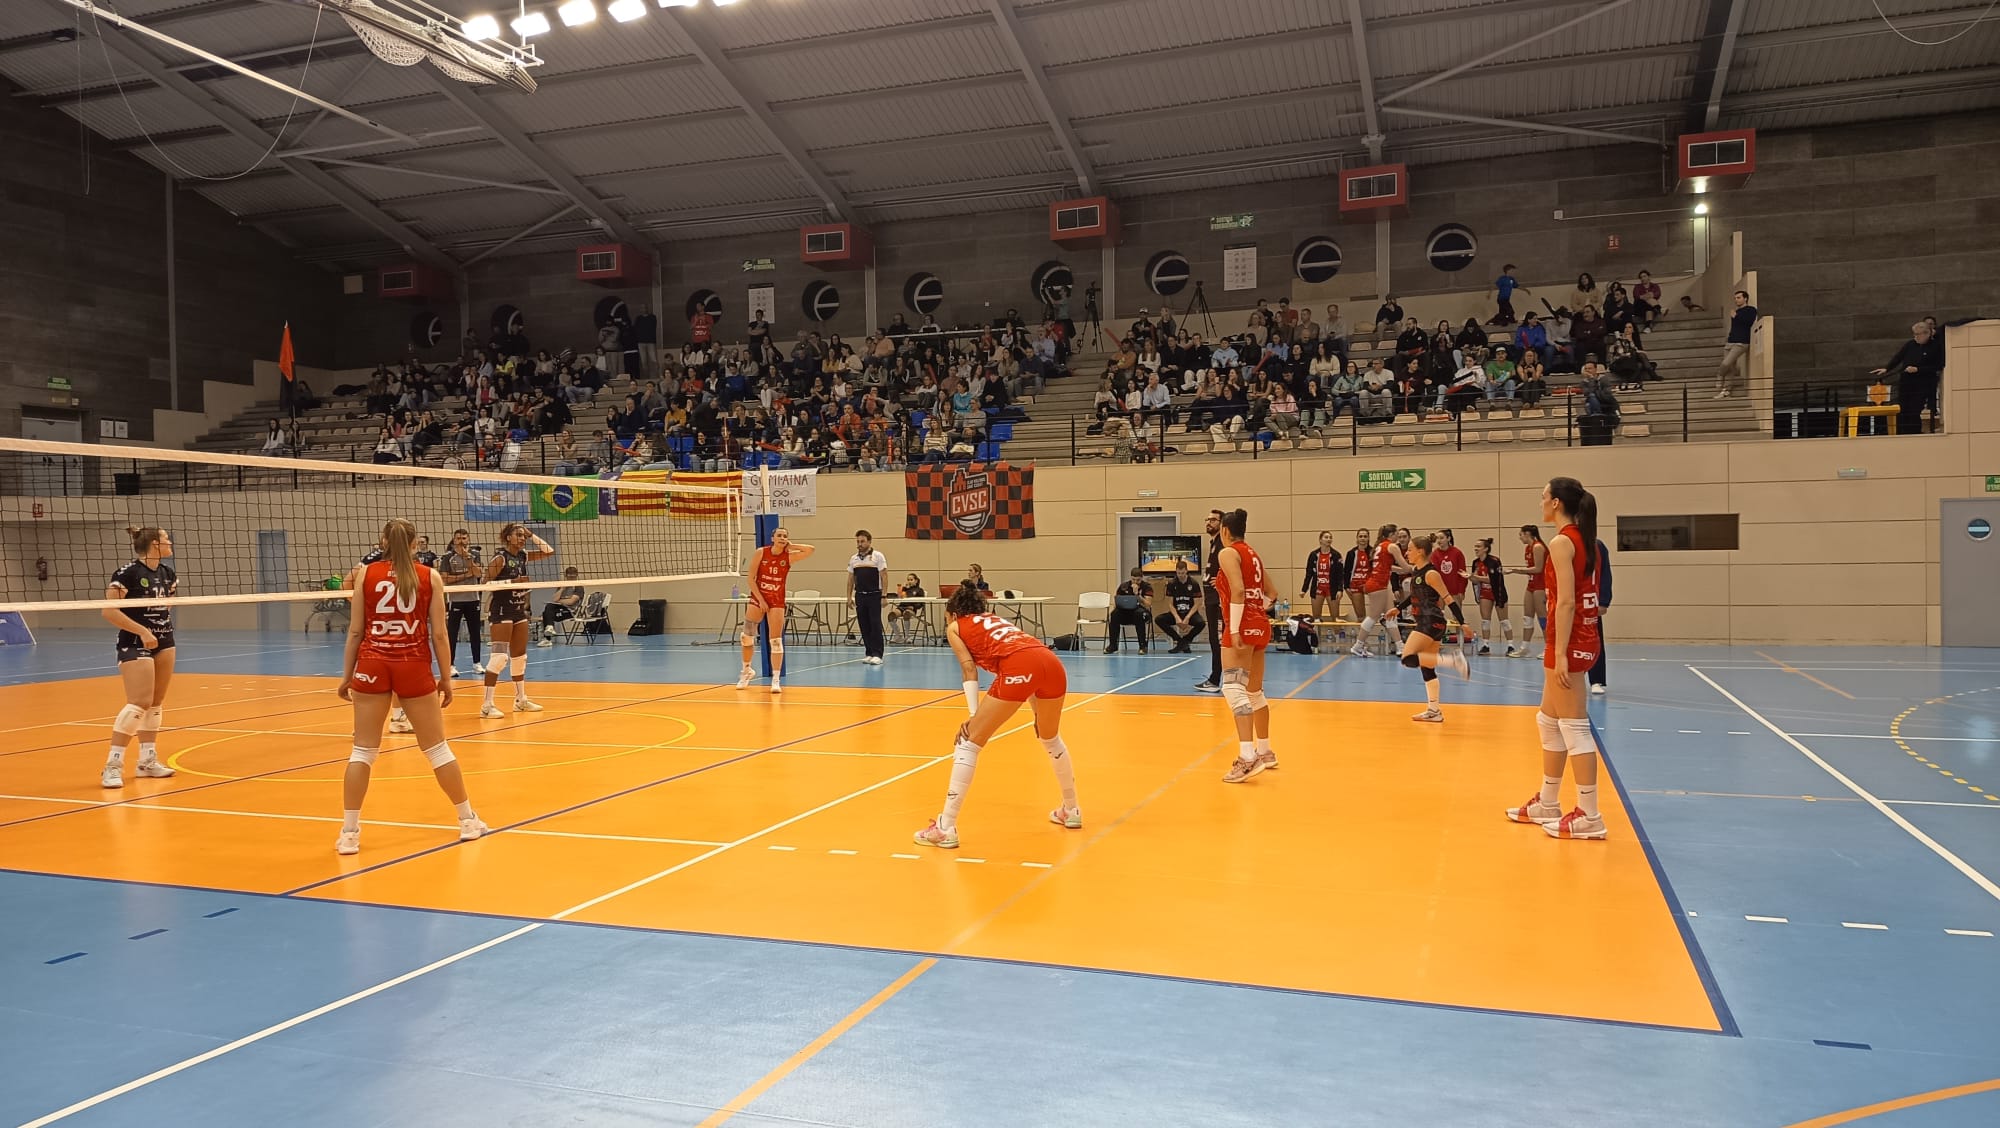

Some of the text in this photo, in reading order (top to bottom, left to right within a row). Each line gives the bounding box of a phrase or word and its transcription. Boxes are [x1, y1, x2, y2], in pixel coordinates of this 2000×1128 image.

[1368, 472, 1394, 481] SORTIDA
[952, 489, 988, 515] CVSC
[769, 566, 779, 575] 16
[1252, 557, 1262, 583] 3
[760, 581, 781, 591] DSV
[375, 580, 417, 614] 20
[371, 619, 420, 635] DSV
[1243, 628, 1265, 637] DSV
[1572, 650, 1596, 661] DSV
[1004, 673, 1033, 685] DSV
